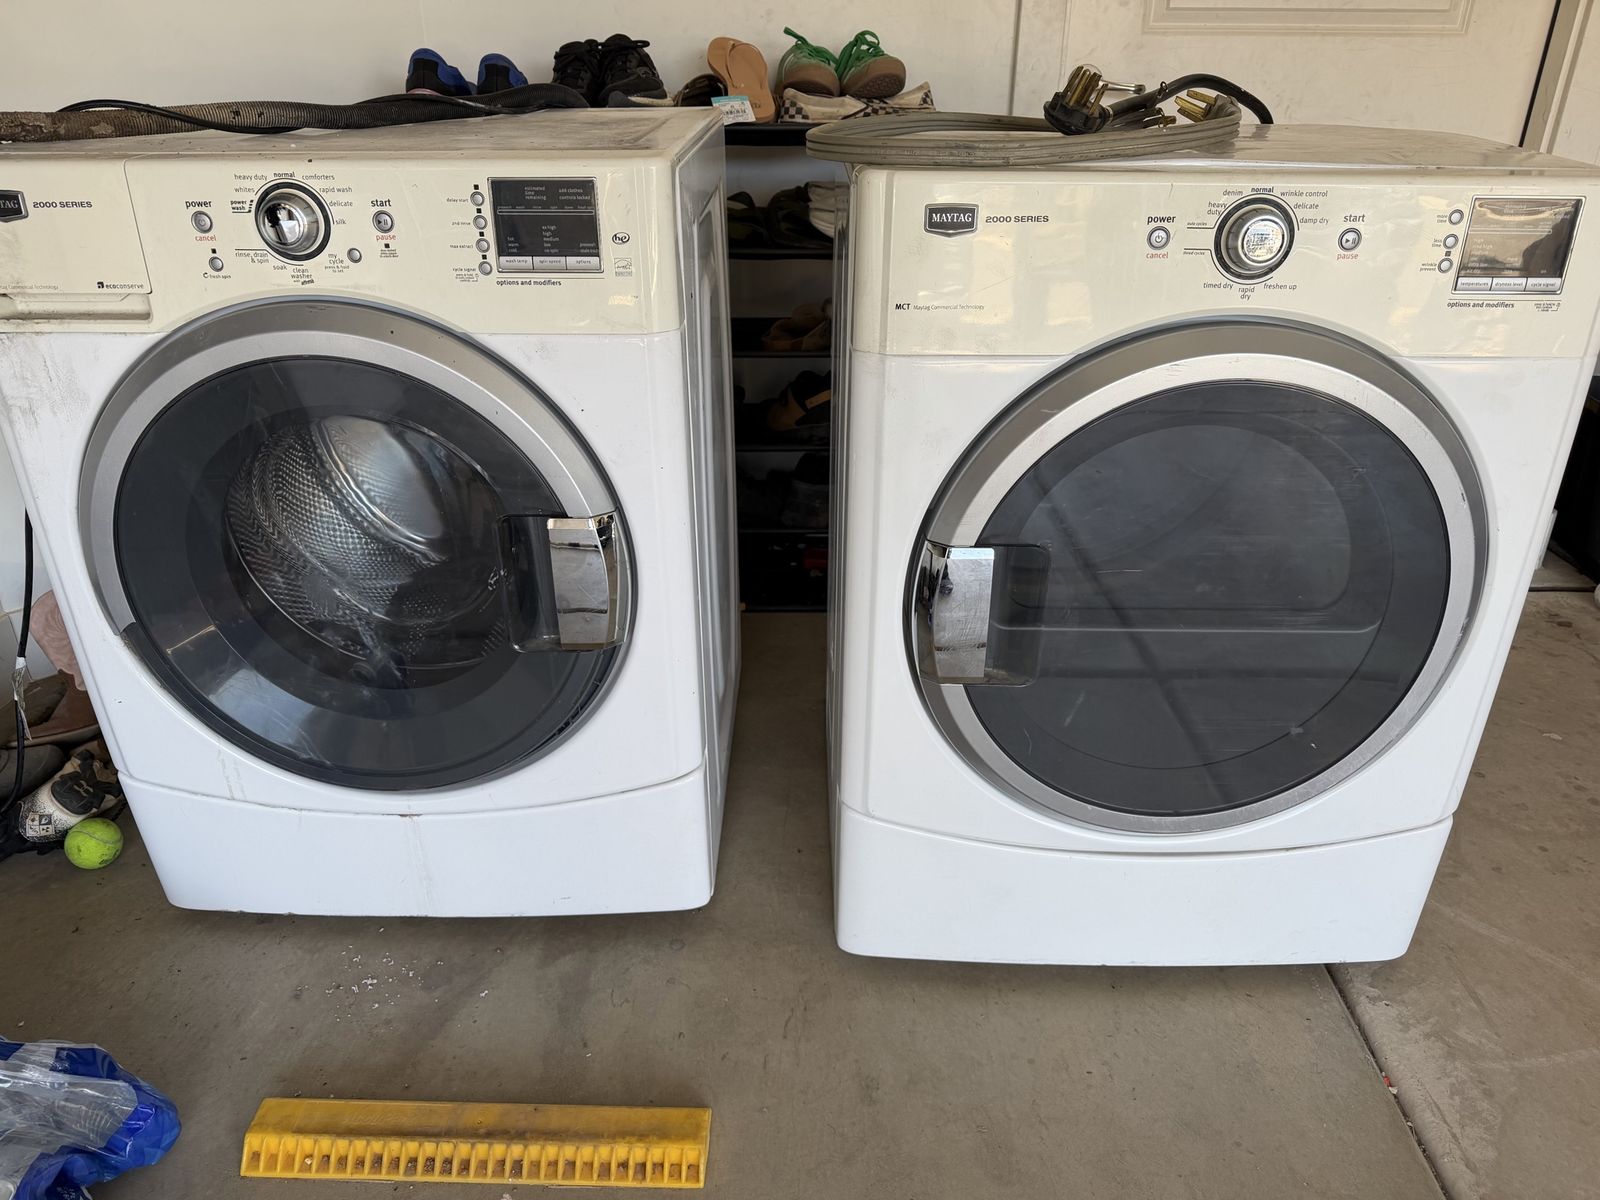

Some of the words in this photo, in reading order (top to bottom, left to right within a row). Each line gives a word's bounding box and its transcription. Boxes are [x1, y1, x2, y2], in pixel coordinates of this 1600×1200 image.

[32, 201, 58, 209] 2000
[185, 200, 212, 210] power
[371, 199, 392, 207] start
[931, 213, 972, 222] MAYTAG
[985, 215, 1012, 223] 2000
[1014, 215, 1049, 223] SERIES
[1147, 216, 1176, 225] power
[1343, 214, 1365, 222] start
[376, 234, 397, 242] pause
[1223, 282, 1234, 290] dry
[1240, 292, 1251, 300] dry
[1486, 301, 1514, 309] modifiers
